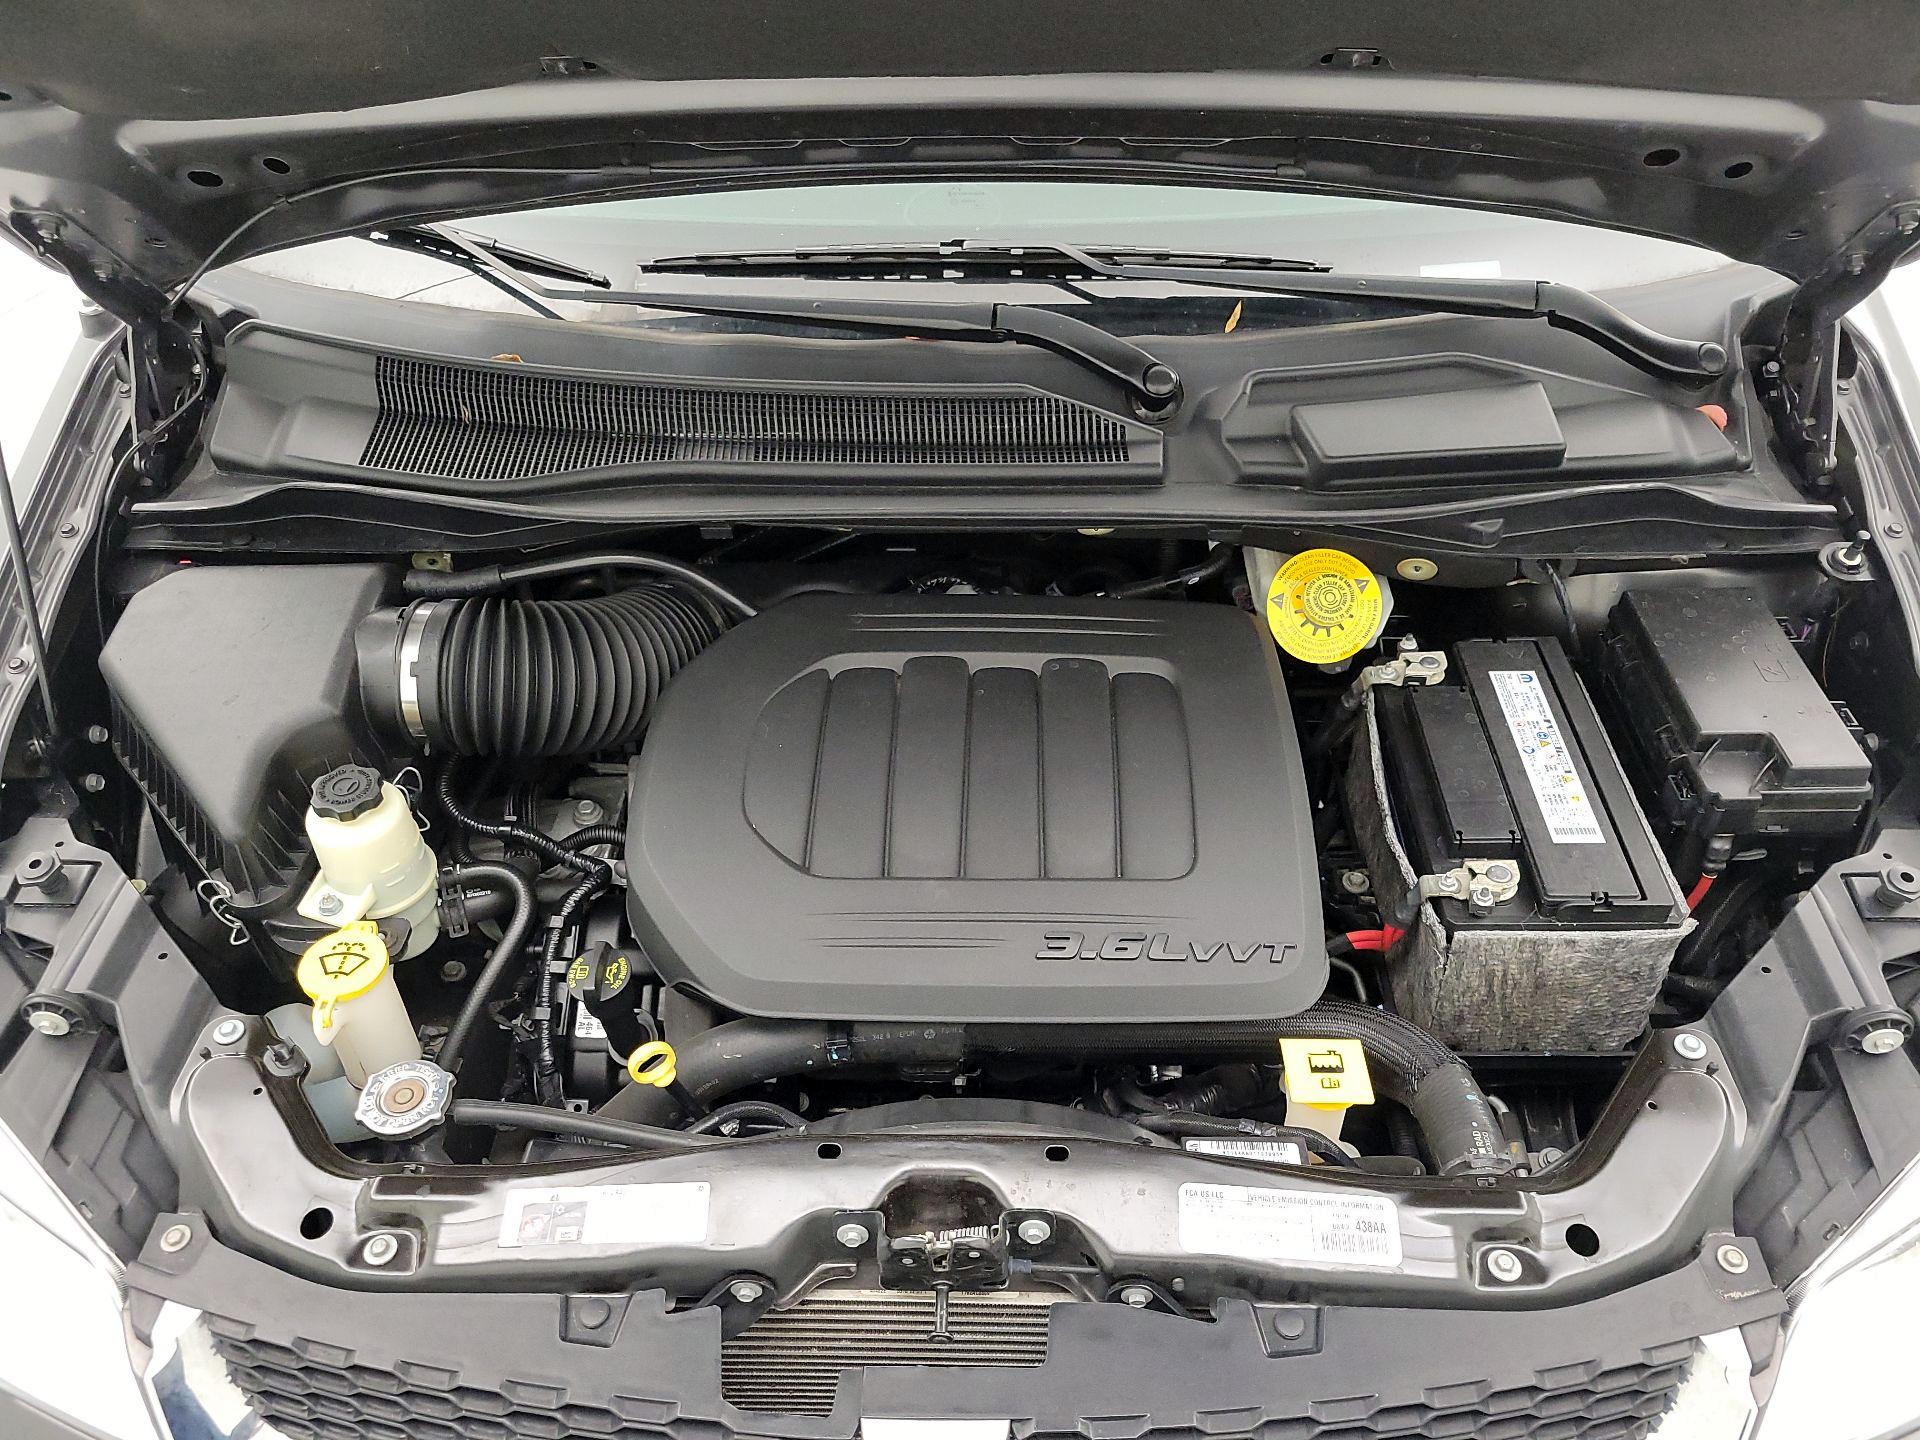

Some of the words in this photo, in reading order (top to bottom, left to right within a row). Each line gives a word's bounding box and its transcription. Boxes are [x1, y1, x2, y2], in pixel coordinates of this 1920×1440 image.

[1189, 942, 1297, 963] VVT
[1473, 1130, 1484, 1147] RAD
[1355, 1220, 1387, 1234] 438AA
